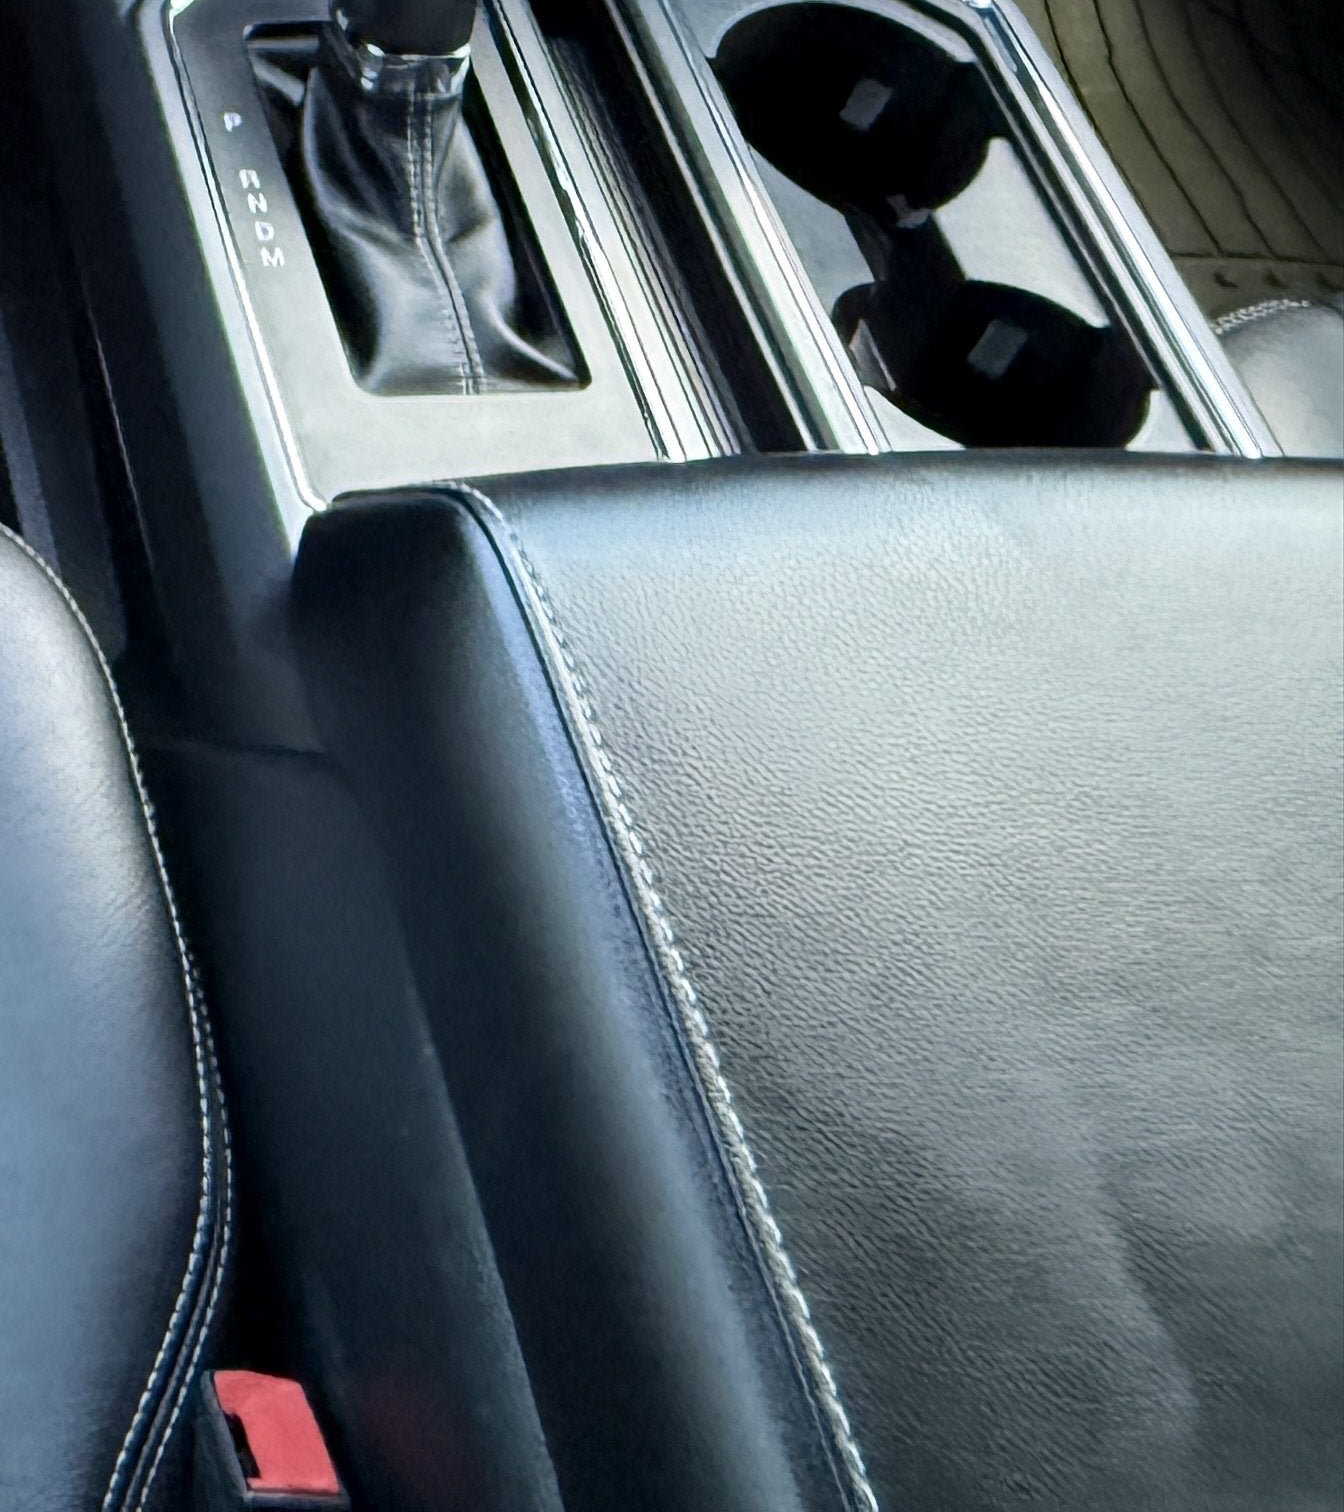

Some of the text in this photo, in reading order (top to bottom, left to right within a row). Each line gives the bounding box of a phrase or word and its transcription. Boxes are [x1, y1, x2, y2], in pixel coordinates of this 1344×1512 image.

[222, 111, 286, 268] P R N D M
